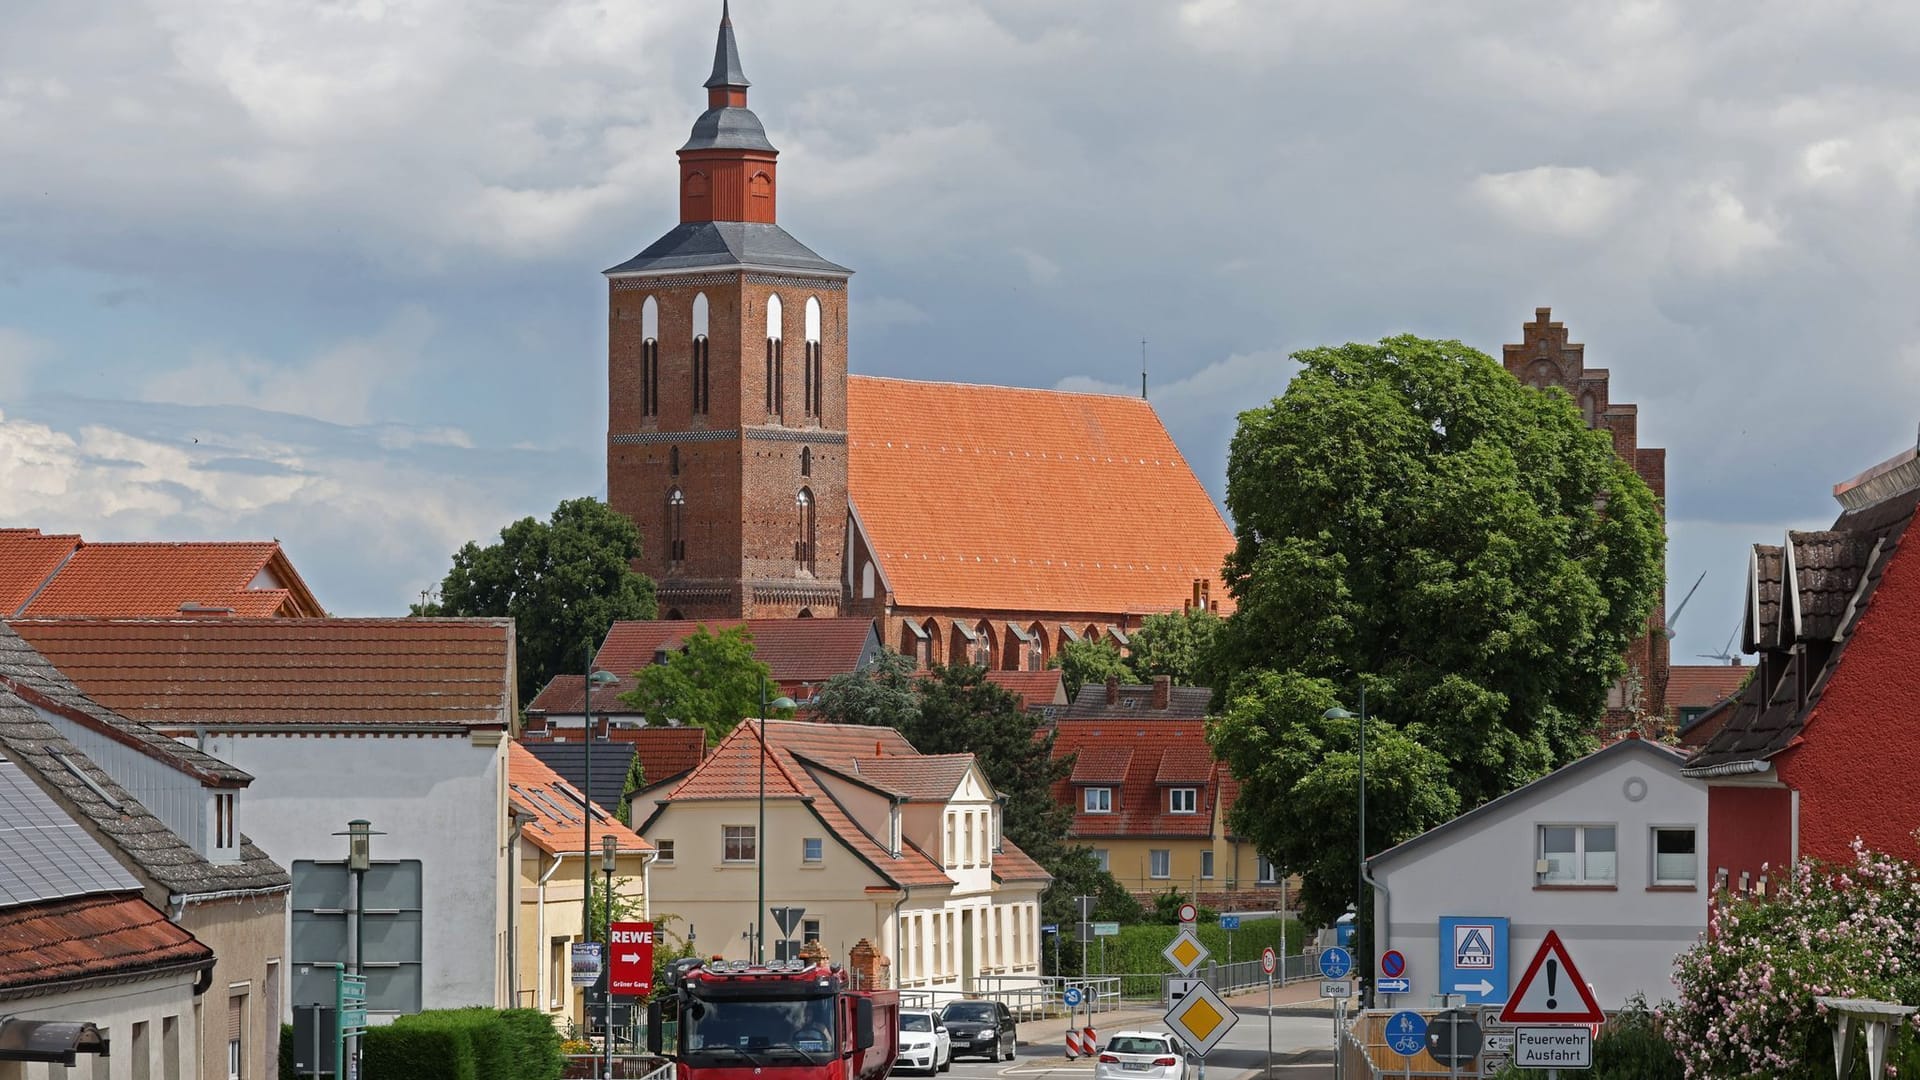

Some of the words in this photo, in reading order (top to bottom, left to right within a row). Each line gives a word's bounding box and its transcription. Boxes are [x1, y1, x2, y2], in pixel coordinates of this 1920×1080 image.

[612, 931, 652, 944] REWE
[1461, 956, 1488, 964] ALDI
[1519, 1033, 1586, 1045] Feuerwehr
[1526, 1049, 1580, 1061] Ausfahrt
